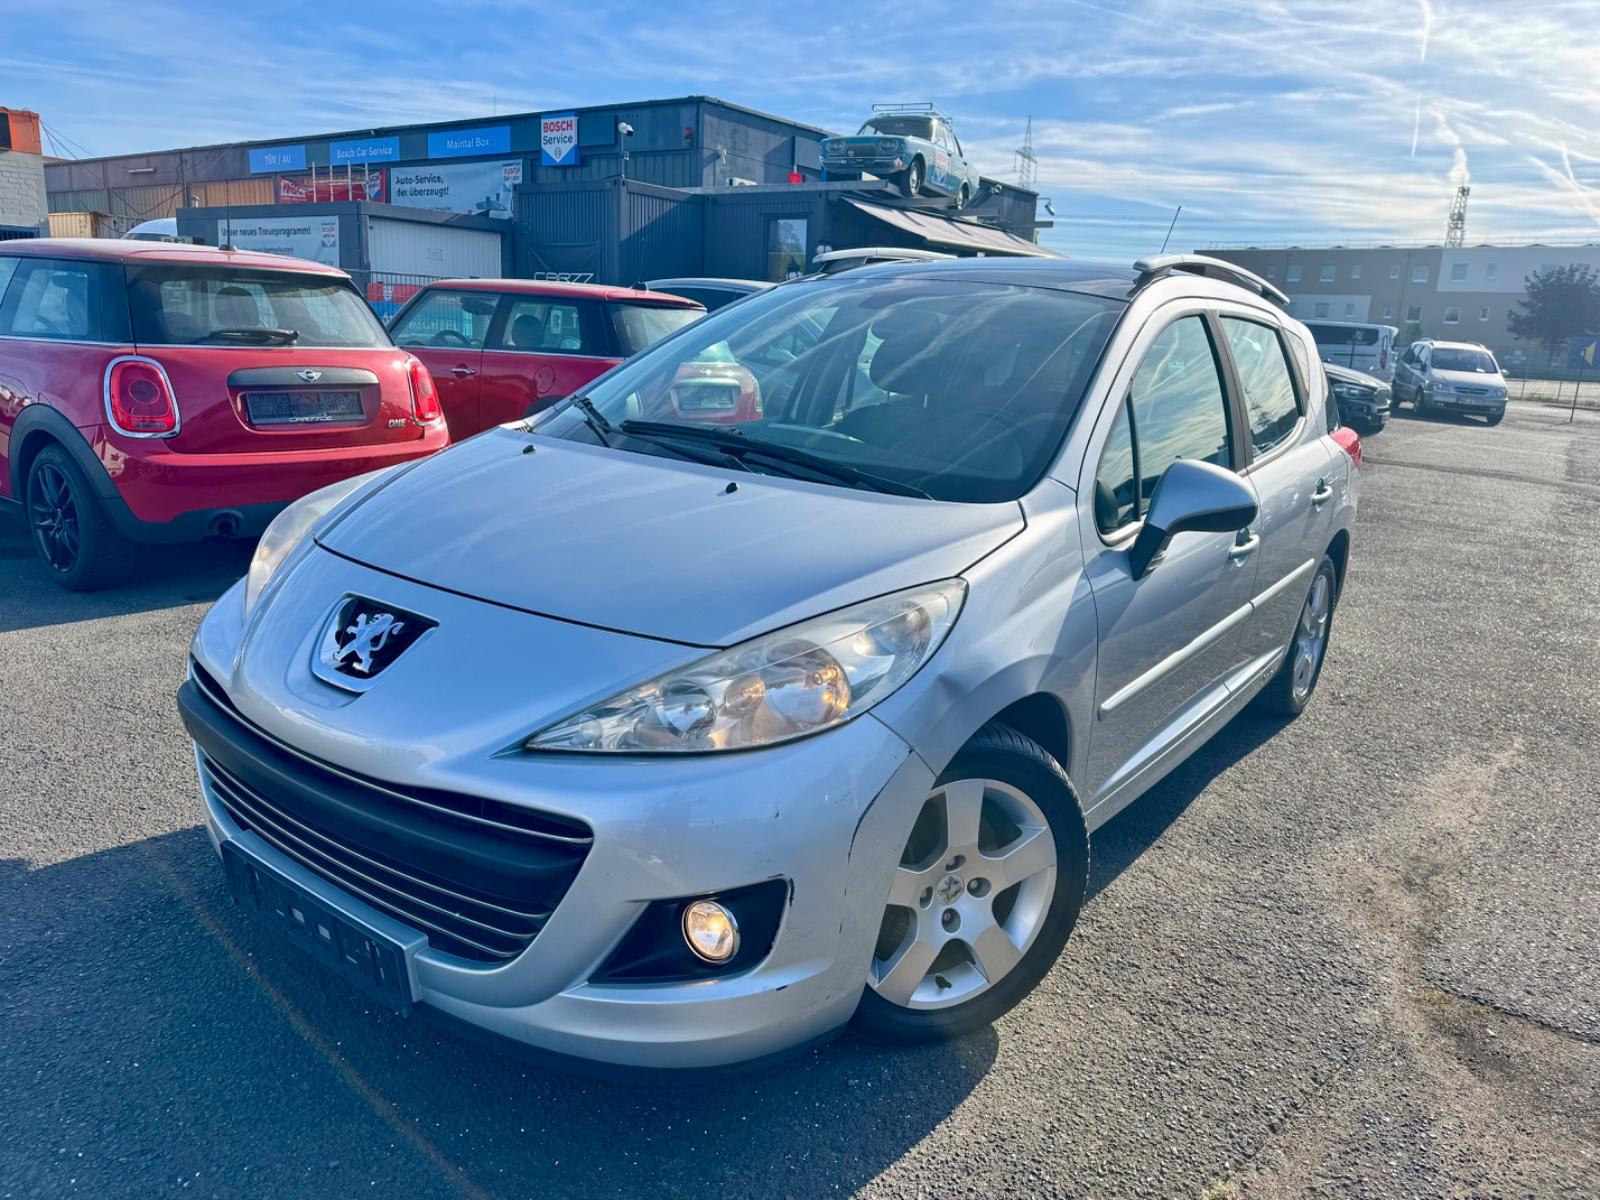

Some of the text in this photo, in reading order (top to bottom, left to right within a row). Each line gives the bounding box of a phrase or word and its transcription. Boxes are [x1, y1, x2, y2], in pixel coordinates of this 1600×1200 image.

[543, 120, 573, 132] BOSCH
[447, 137, 489, 149] Maintal Box
[543, 134, 573, 145] Service
[337, 146, 392, 158] Bosch Car Service
[265, 153, 277, 165] TÜV
[395, 174, 444, 185] Auto-Service,
[396, 186, 449, 198] der überzeugt!
[240, 228, 257, 236] neues
[258, 226, 311, 238] Treueprogramm!
[388, 418, 406, 428] ONE
